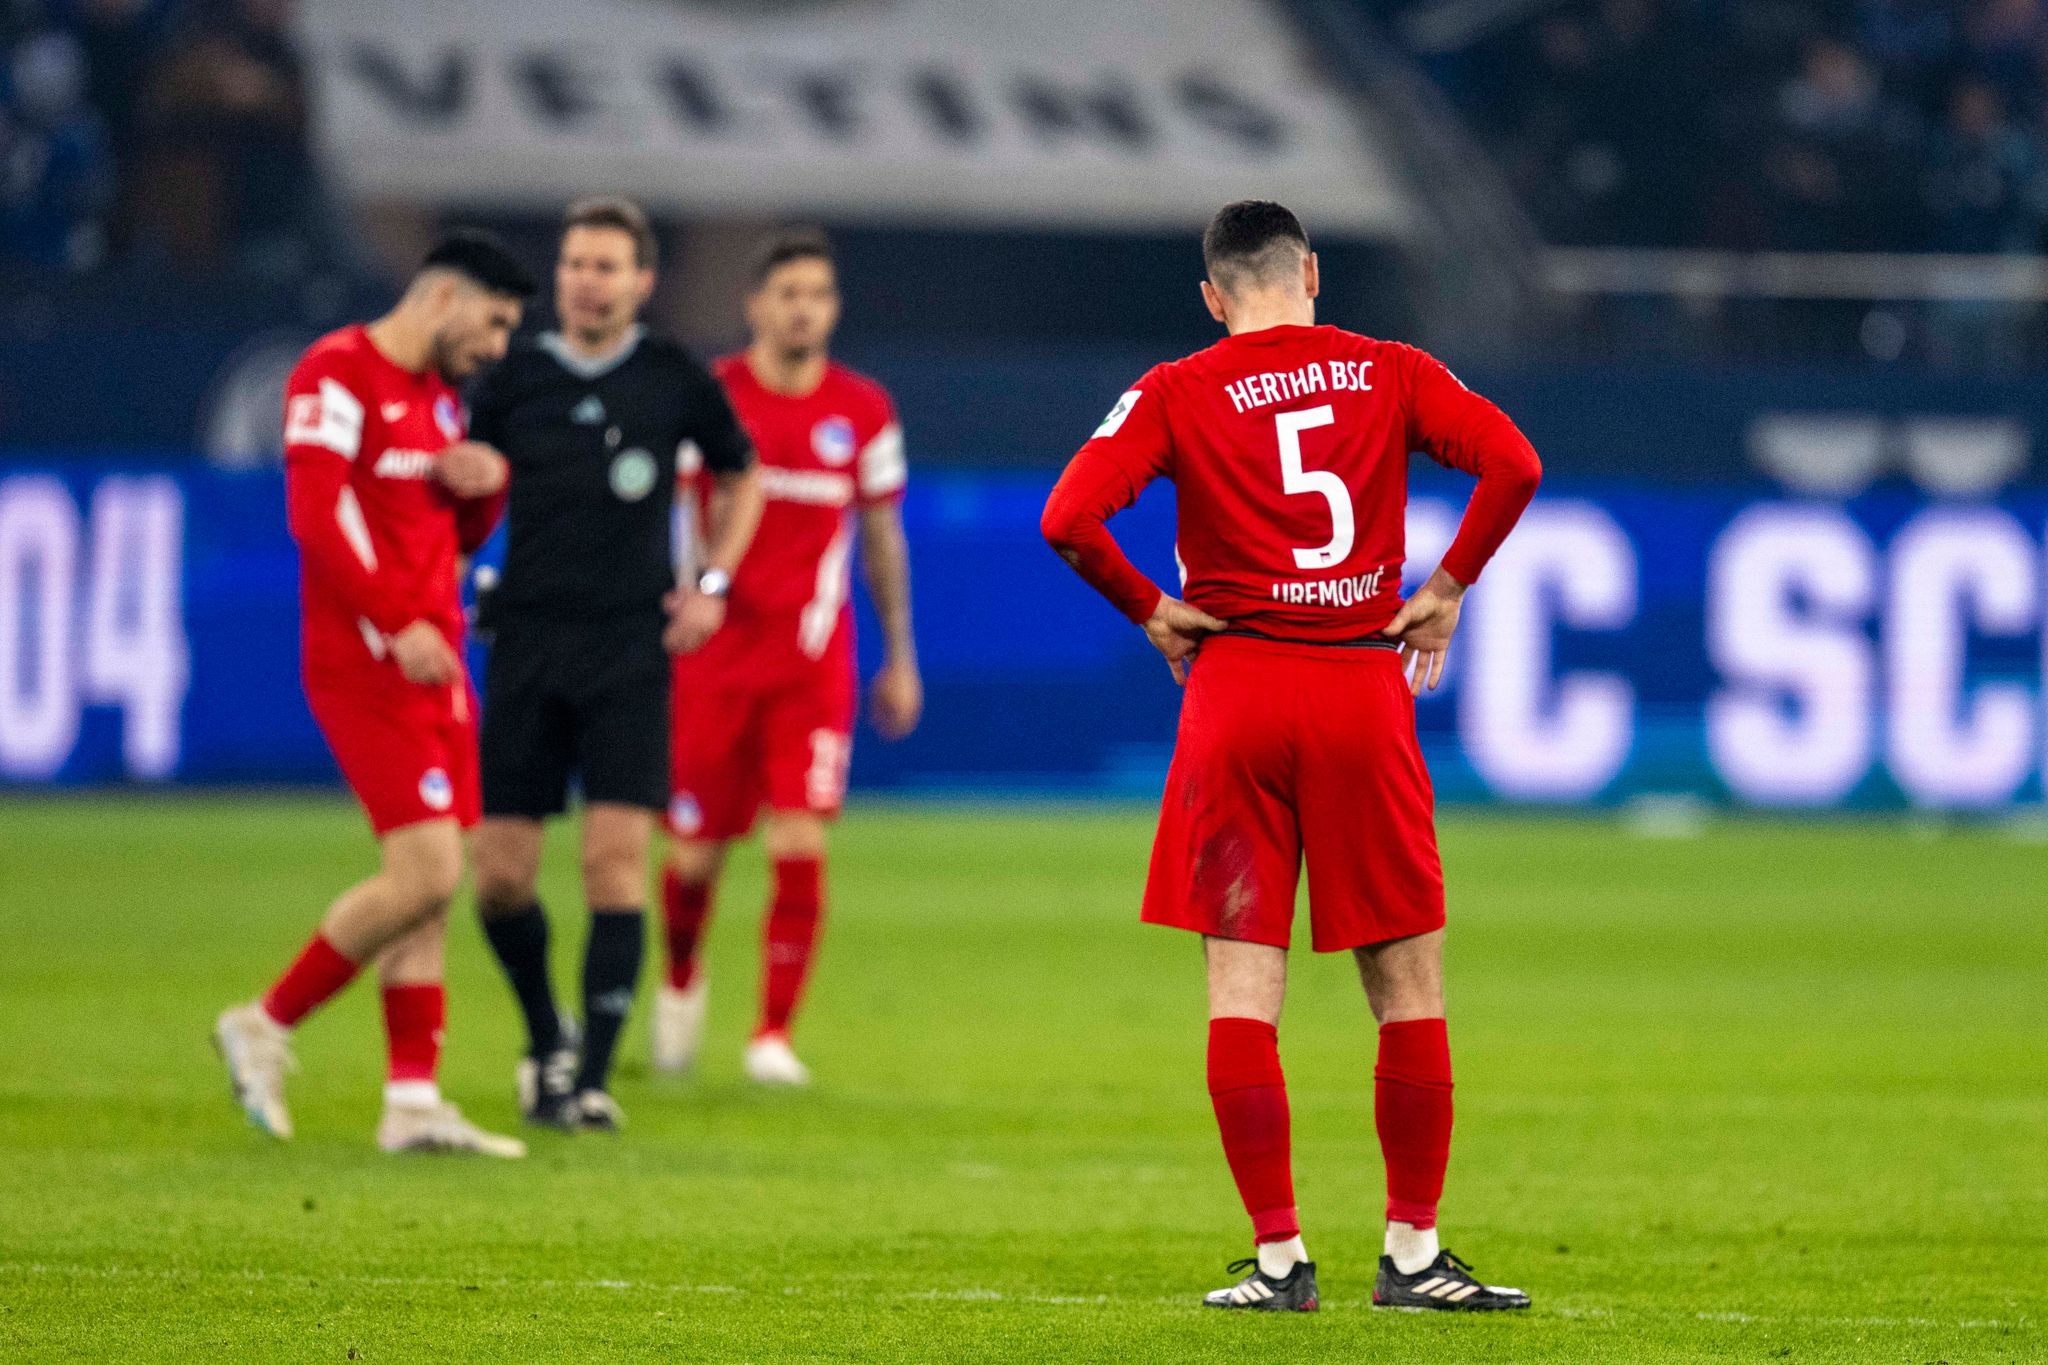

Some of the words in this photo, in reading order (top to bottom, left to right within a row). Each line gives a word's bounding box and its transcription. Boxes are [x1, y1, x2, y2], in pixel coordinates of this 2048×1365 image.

[1224, 362, 1328, 414] HERTHA
[1328, 360, 1374, 392] BSC
[1275, 404, 1355, 570] 5
[0, 474, 191, 778] 04
[1705, 500, 2048, 806] SC
